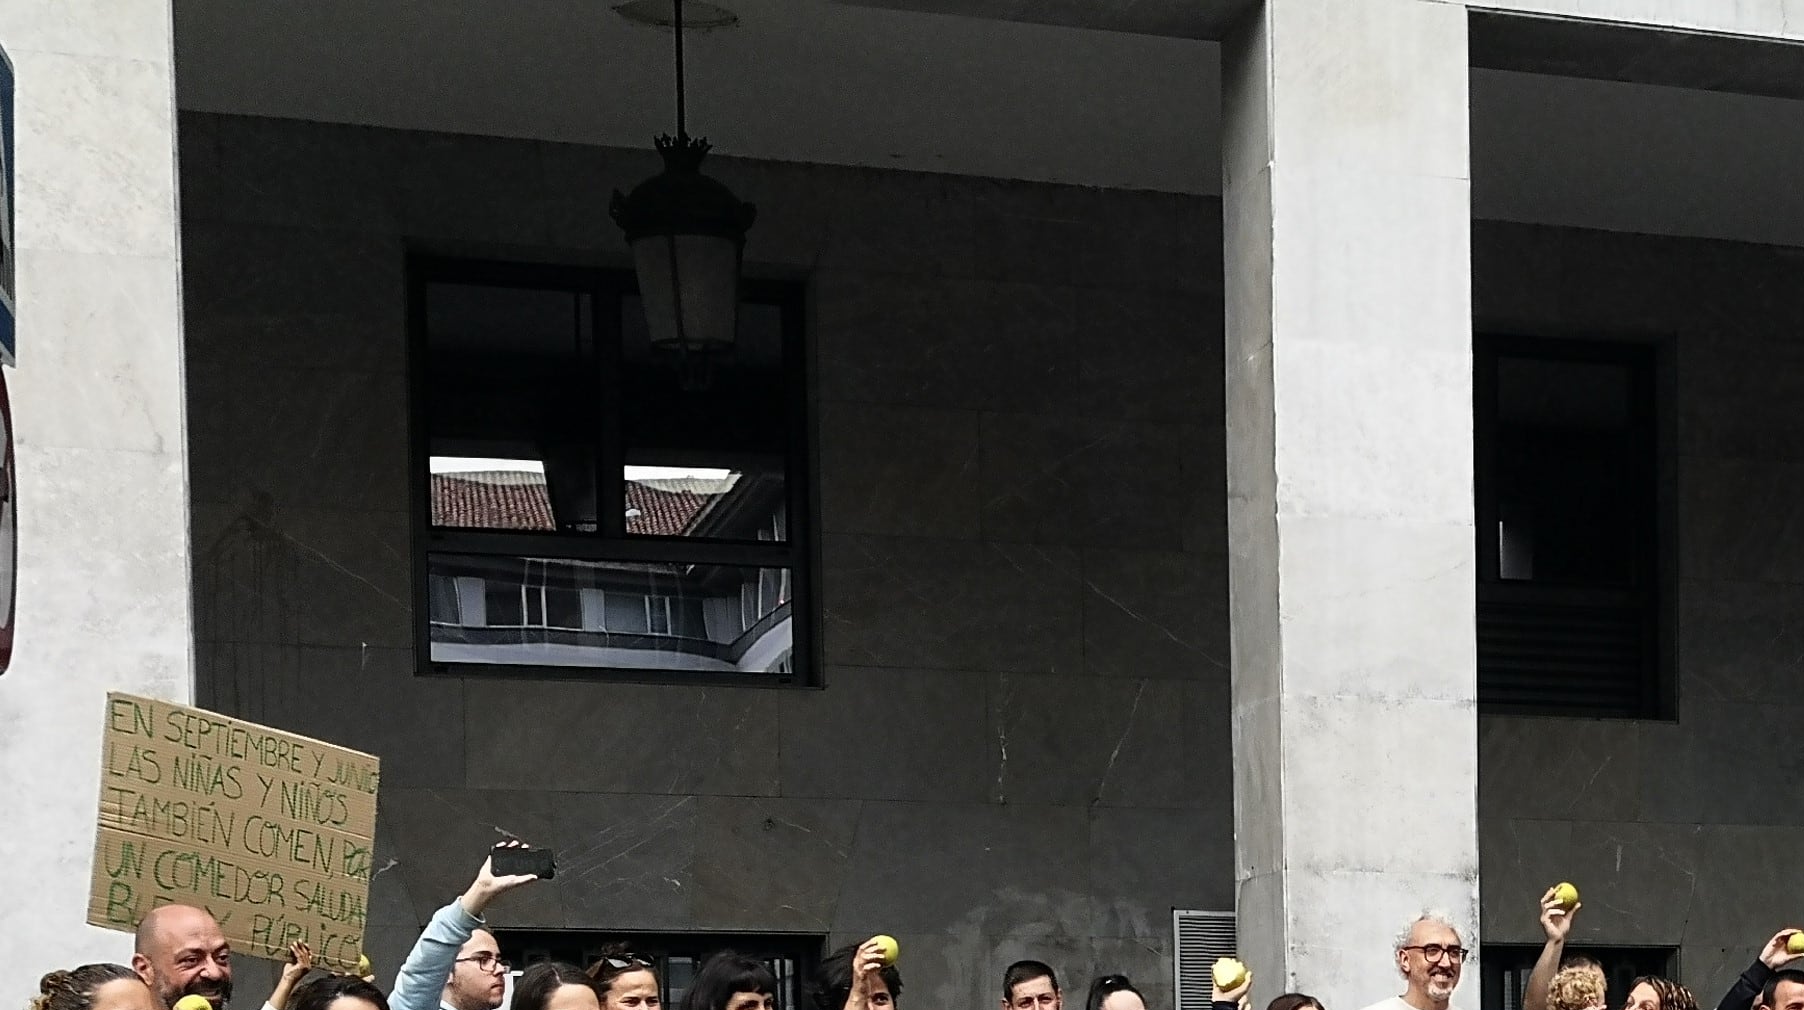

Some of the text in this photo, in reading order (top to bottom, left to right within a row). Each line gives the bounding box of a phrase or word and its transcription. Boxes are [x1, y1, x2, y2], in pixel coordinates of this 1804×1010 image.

[110, 699, 154, 739] EN
[164, 711, 304, 774] SEPTIEMBRE
[311, 750, 326, 779] Y
[107, 786, 235, 849] TAMBIÉN
[108, 744, 348, 825] LAS NIÑAS Y NIÑOS
[103, 842, 146, 879] UN
[154, 850, 286, 906] COMEDOR
